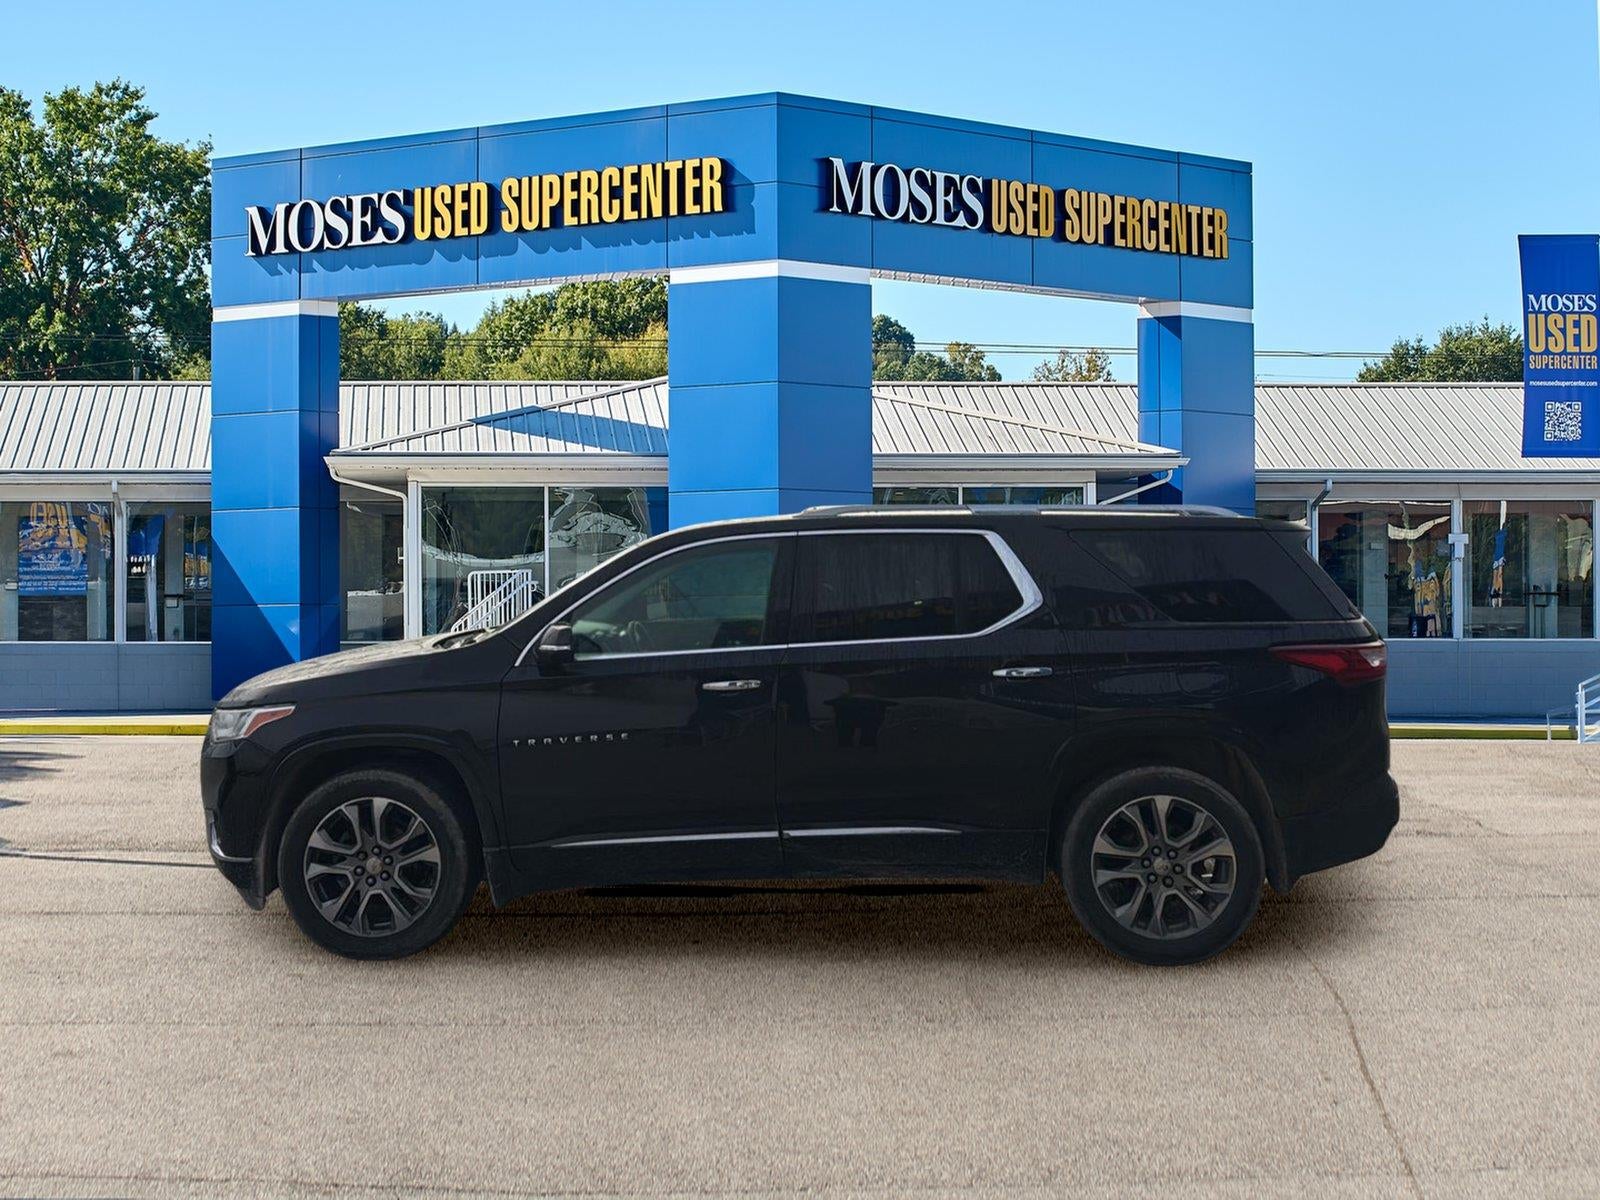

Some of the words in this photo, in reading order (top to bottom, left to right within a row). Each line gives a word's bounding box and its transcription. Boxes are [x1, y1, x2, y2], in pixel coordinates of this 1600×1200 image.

[245, 190, 406, 257] MOSES
[413, 181, 489, 241] USED
[500, 157, 724, 233] SUPERCENTER
[828, 157, 985, 230] MOSES
[991, 178, 1055, 238] USED
[1064, 188, 1229, 259] SUPERCENTER
[1528, 294, 1597, 312] MOSES
[1528, 314, 1597, 353] USED
[1529, 355, 1597, 369] SUPERCENTER
[512, 732, 629, 747] TRAVERSE
